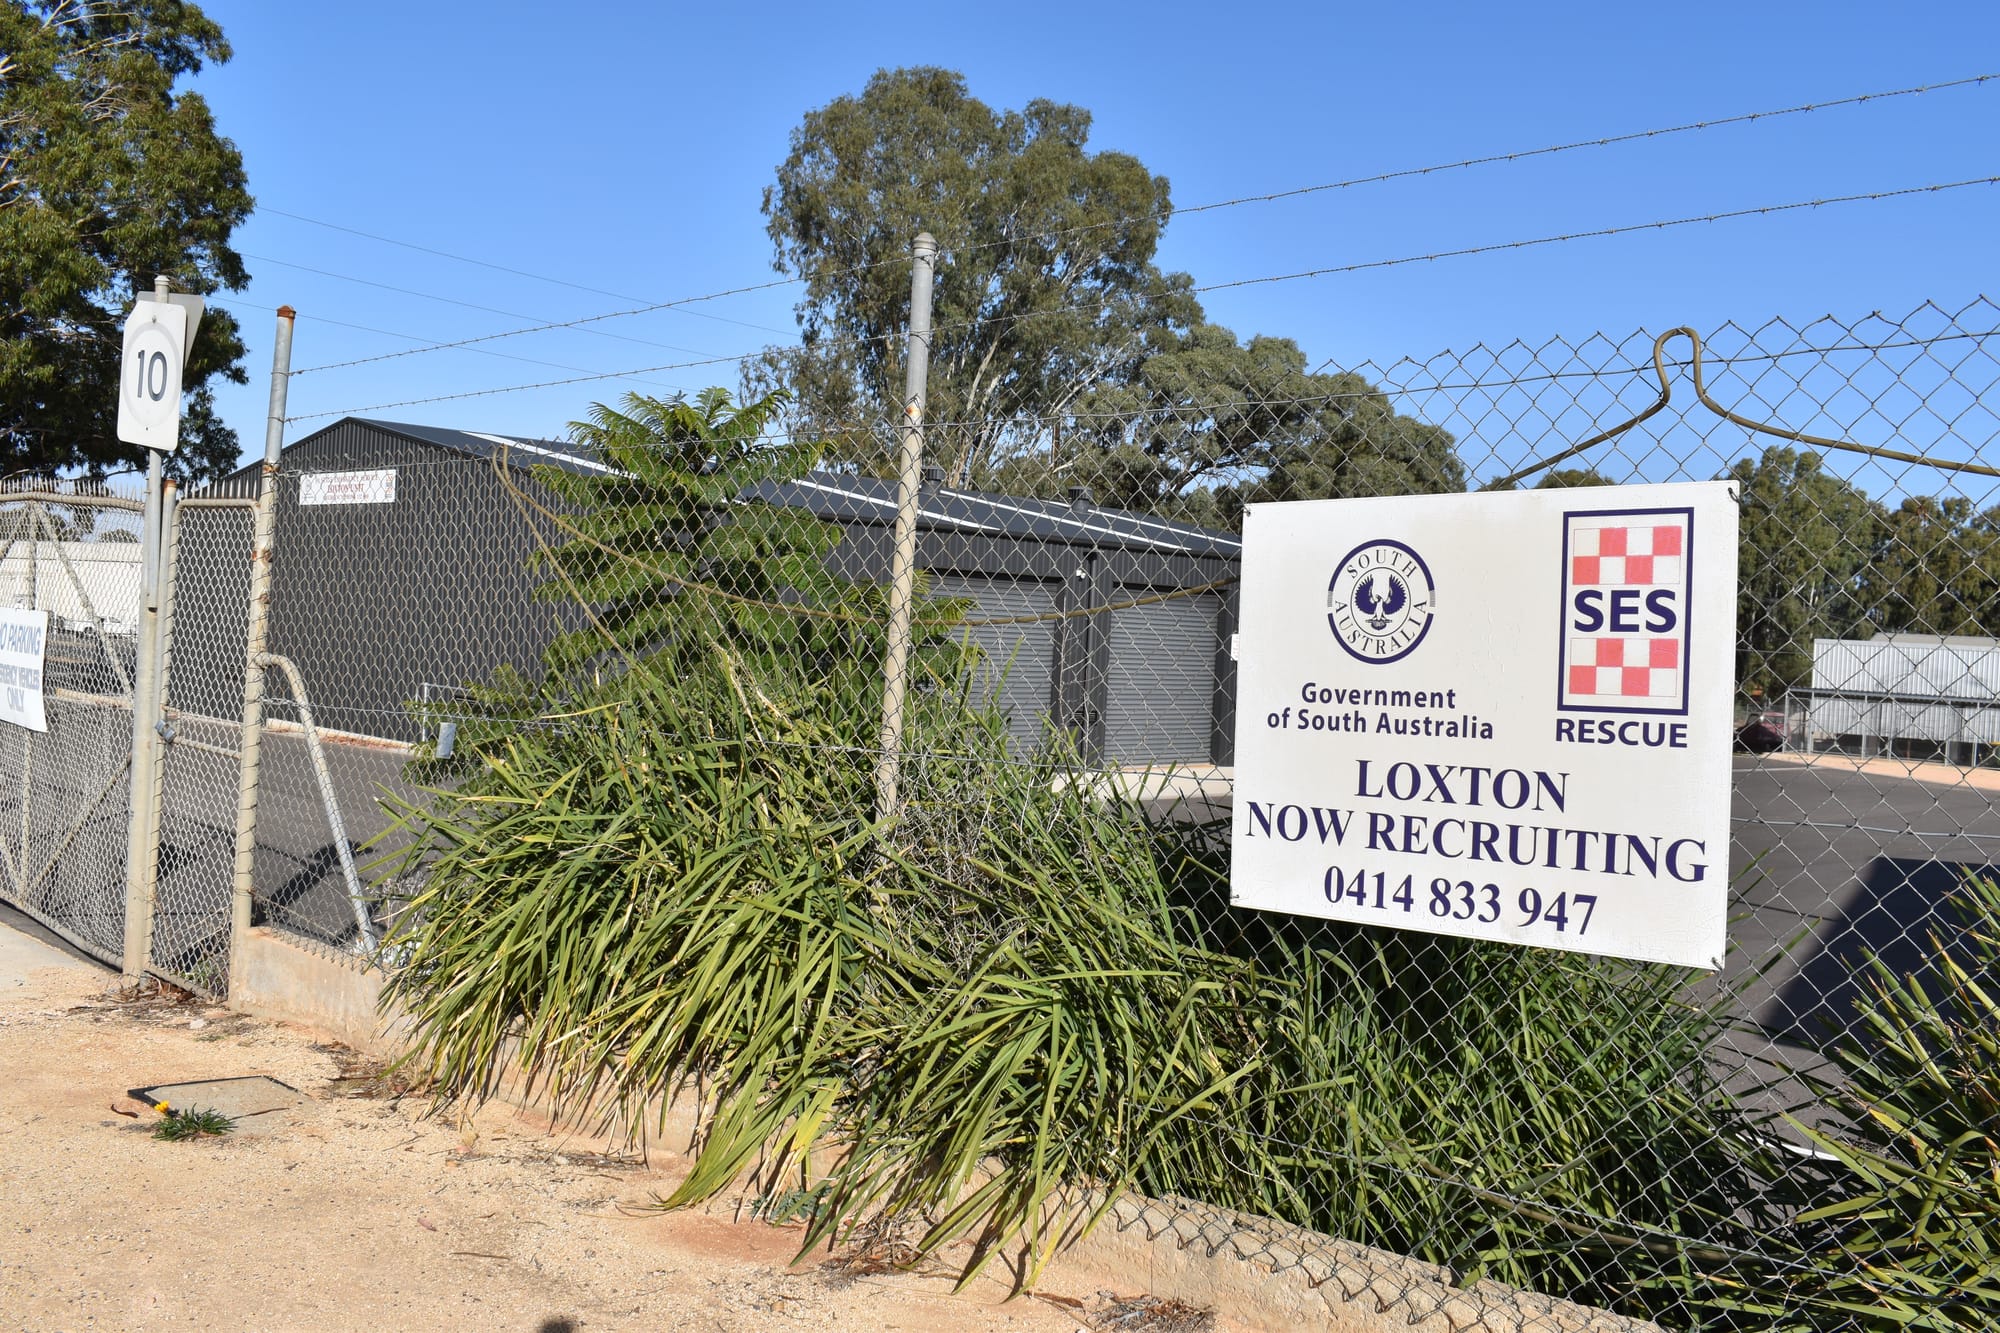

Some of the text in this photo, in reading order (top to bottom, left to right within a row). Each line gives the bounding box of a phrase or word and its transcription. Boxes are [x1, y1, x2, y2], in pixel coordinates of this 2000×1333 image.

[137, 349, 168, 402] 10
[1346, 548, 1418, 579] SOUTH
[1334, 599, 1428, 655] AUSTRALIA
[1574, 589, 1677, 634] SES
[7, 624, 41, 656] PARKING
[7, 686, 24, 712] ONLY
[1301, 682, 1456, 709] Government
[1267, 707, 1494, 740] of South Australia
[1555, 718, 1688, 748] RESCUE
[1355, 759, 1570, 813] LOXTON
[1246, 801, 1709, 883] NOW RECRUITING
[1324, 865, 1598, 935] 0414 833 947
